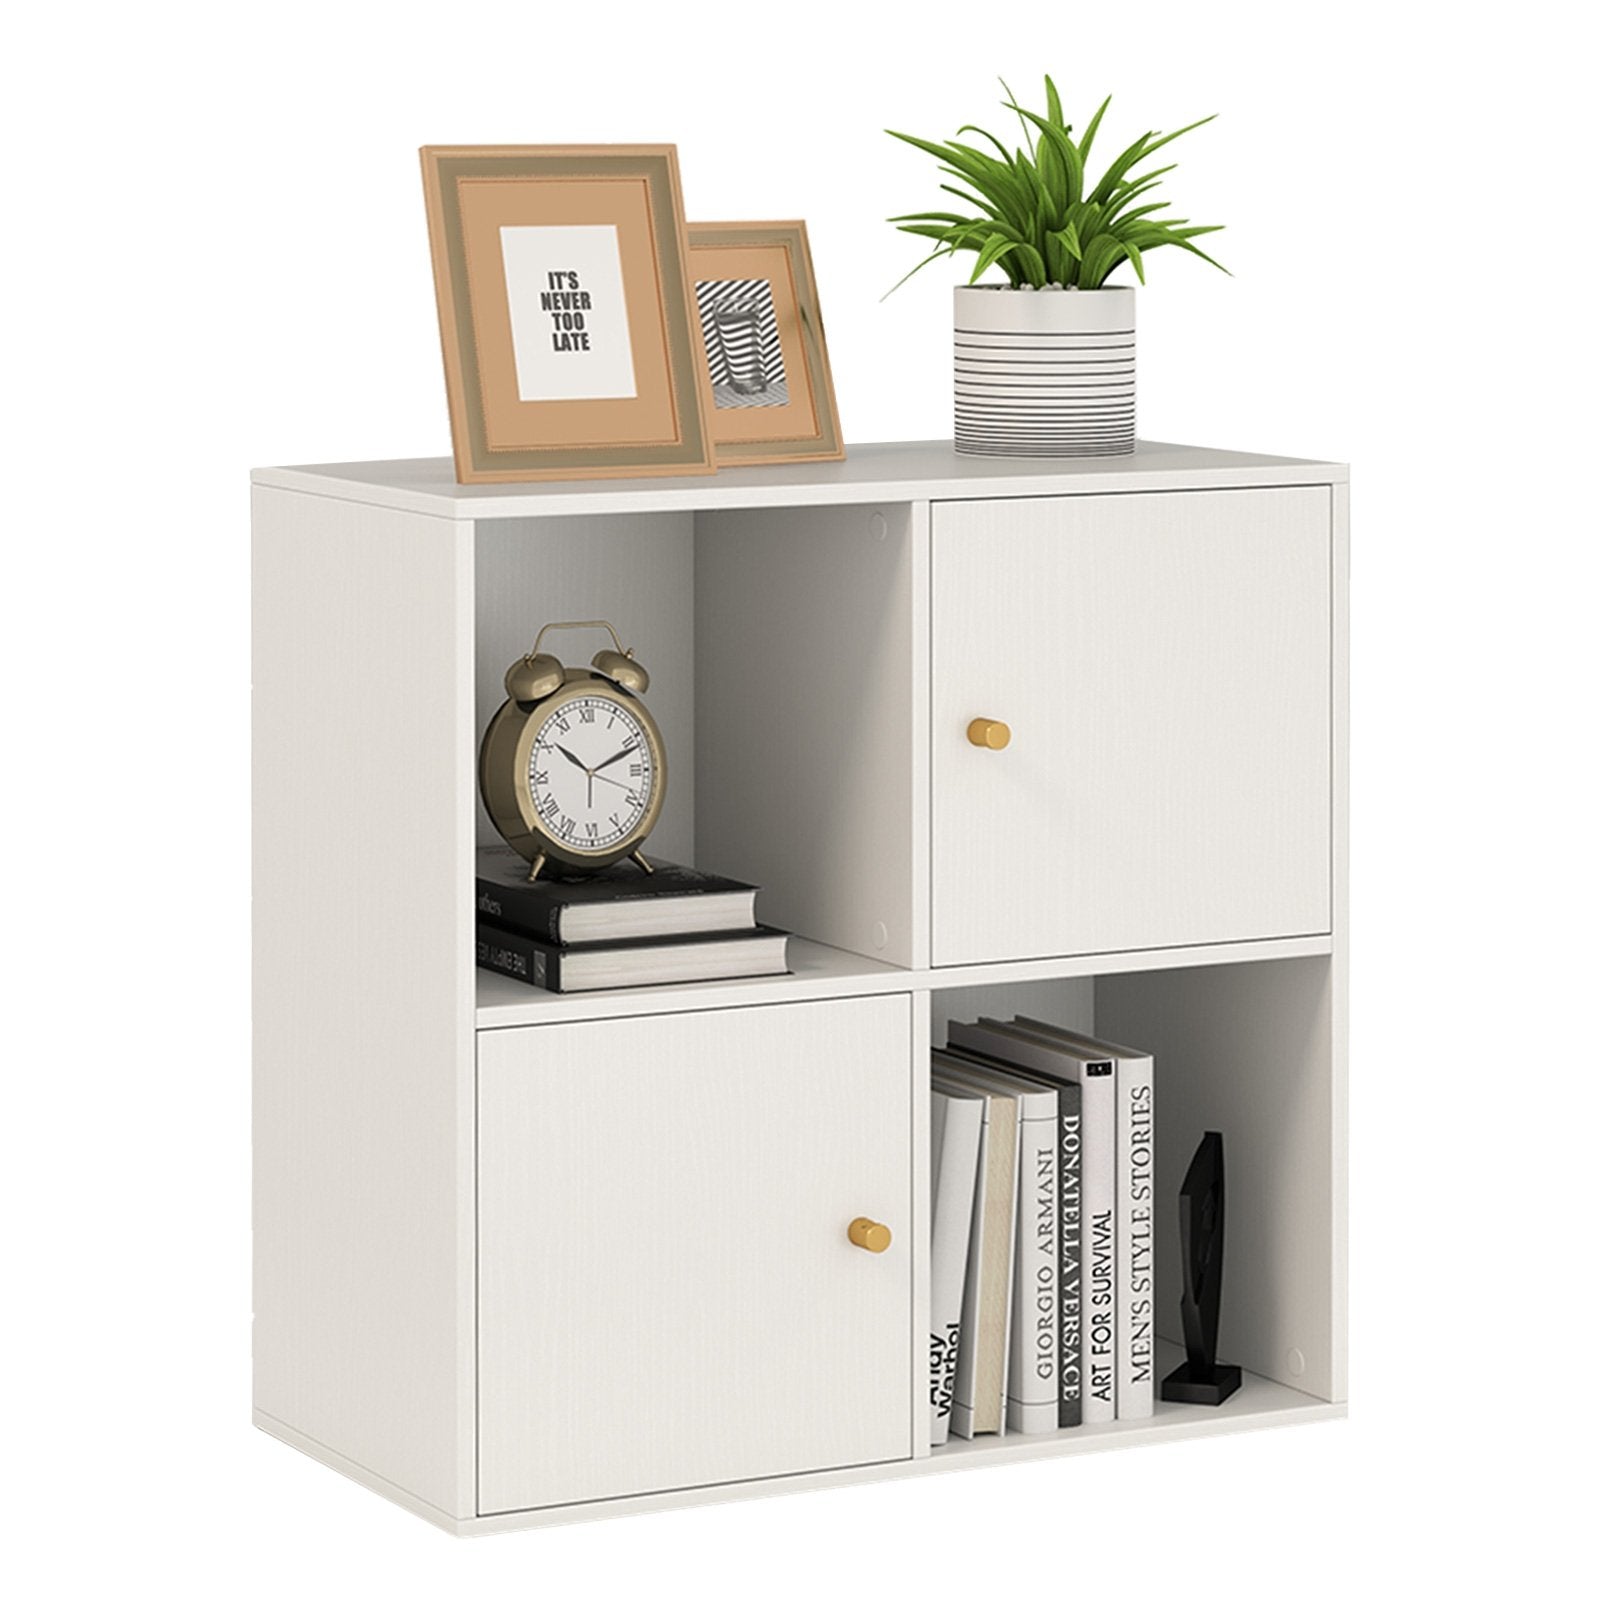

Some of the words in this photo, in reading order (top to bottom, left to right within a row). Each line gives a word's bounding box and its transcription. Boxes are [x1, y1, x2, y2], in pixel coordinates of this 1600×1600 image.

[540, 292, 592, 311] NEVER
[548, 271, 579, 290] IT'S
[551, 312, 585, 331] TOO
[552, 332, 590, 352] LATE
[578, 709, 595, 723] XII
[1131, 1086, 1151, 1201] STORIES
[1037, 1149, 1053, 1255] ARMANI
[1063, 1115, 1080, 1274] DONATELLA
[1091, 1210, 1112, 1305] SURVIVAL
[1131, 1207, 1151, 1293] STYLE
[1037, 1266, 1053, 1379] GIORGIO
[1063, 1279, 1080, 1401] VERSACE
[1091, 1312, 1111, 1355] FOR
[1131, 1300, 1151, 1384] MEN'S
[937, 1323, 960, 1418] Warhol
[1091, 1364, 1111, 1402] ART
